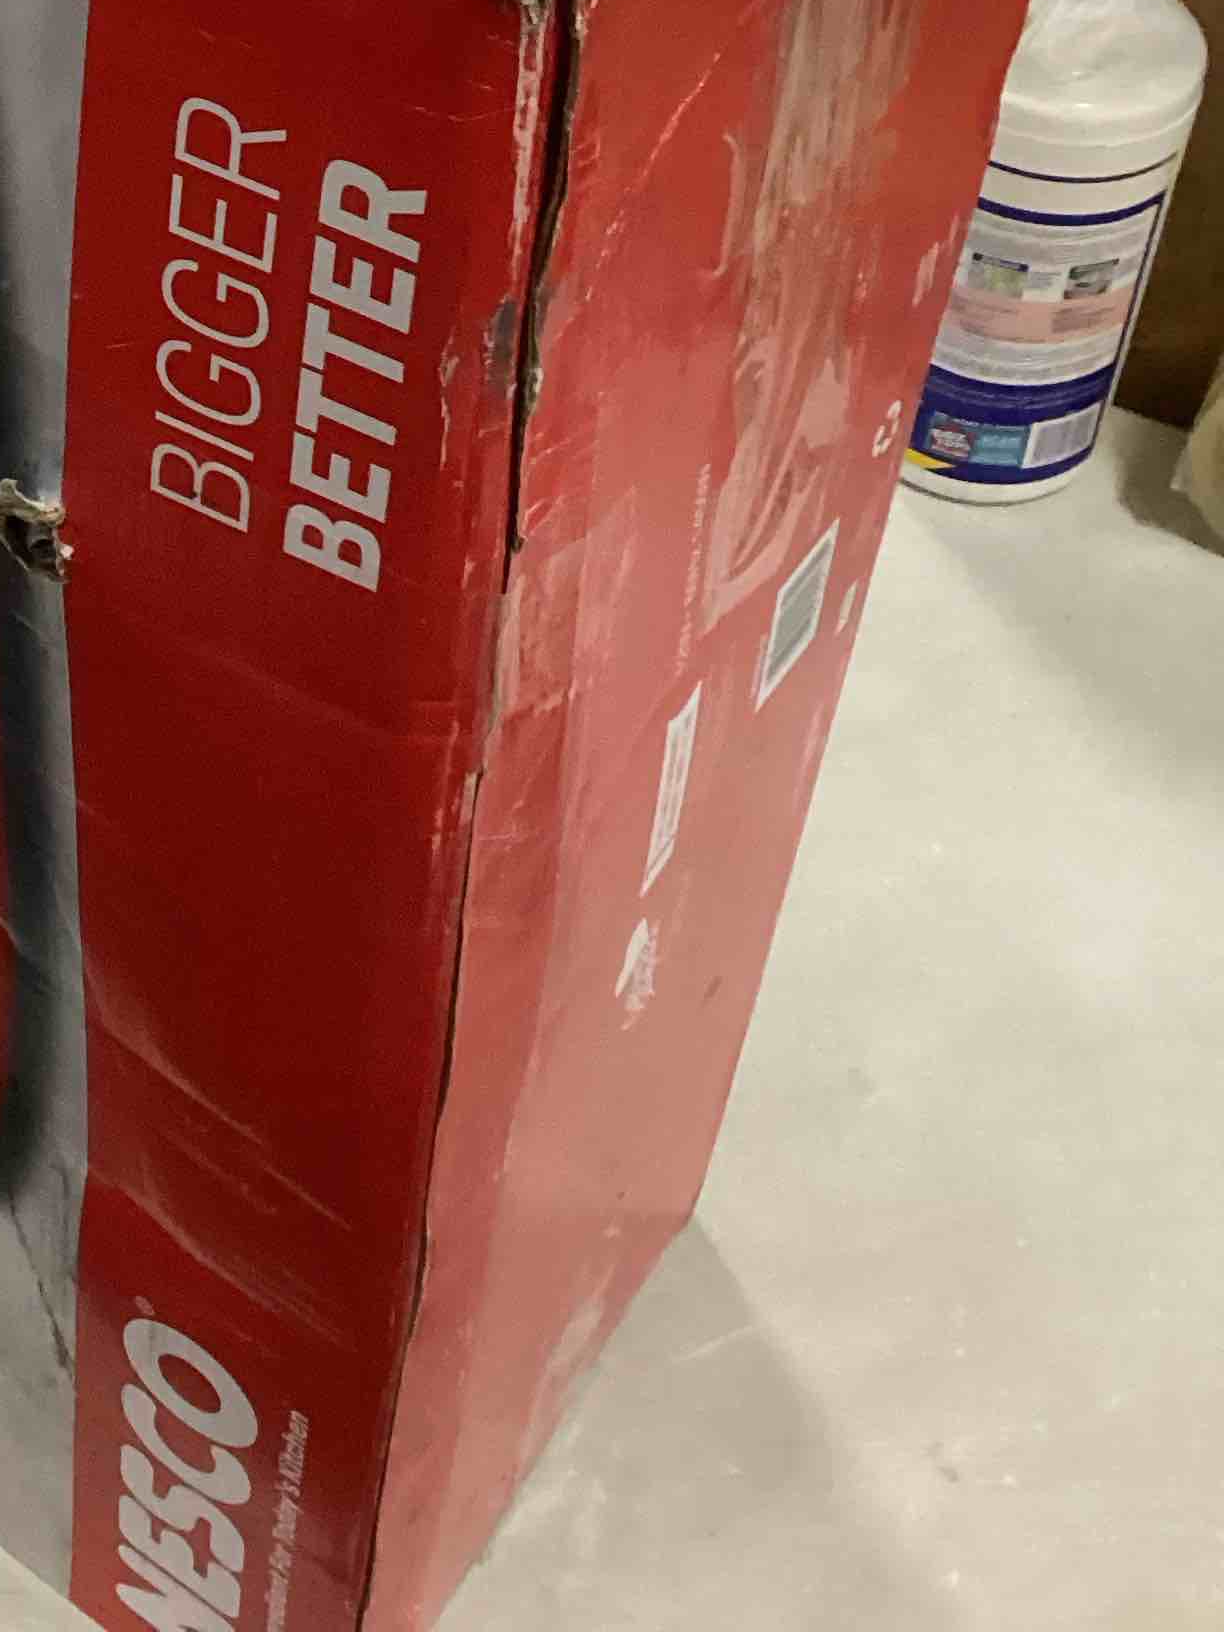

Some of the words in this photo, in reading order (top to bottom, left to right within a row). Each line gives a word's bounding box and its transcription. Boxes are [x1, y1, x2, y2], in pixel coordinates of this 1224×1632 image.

[150, 96, 288, 534] BIGGER
[282, 158, 428, 593] BETTER
[279, 1409, 309, 1486] Kitchen
